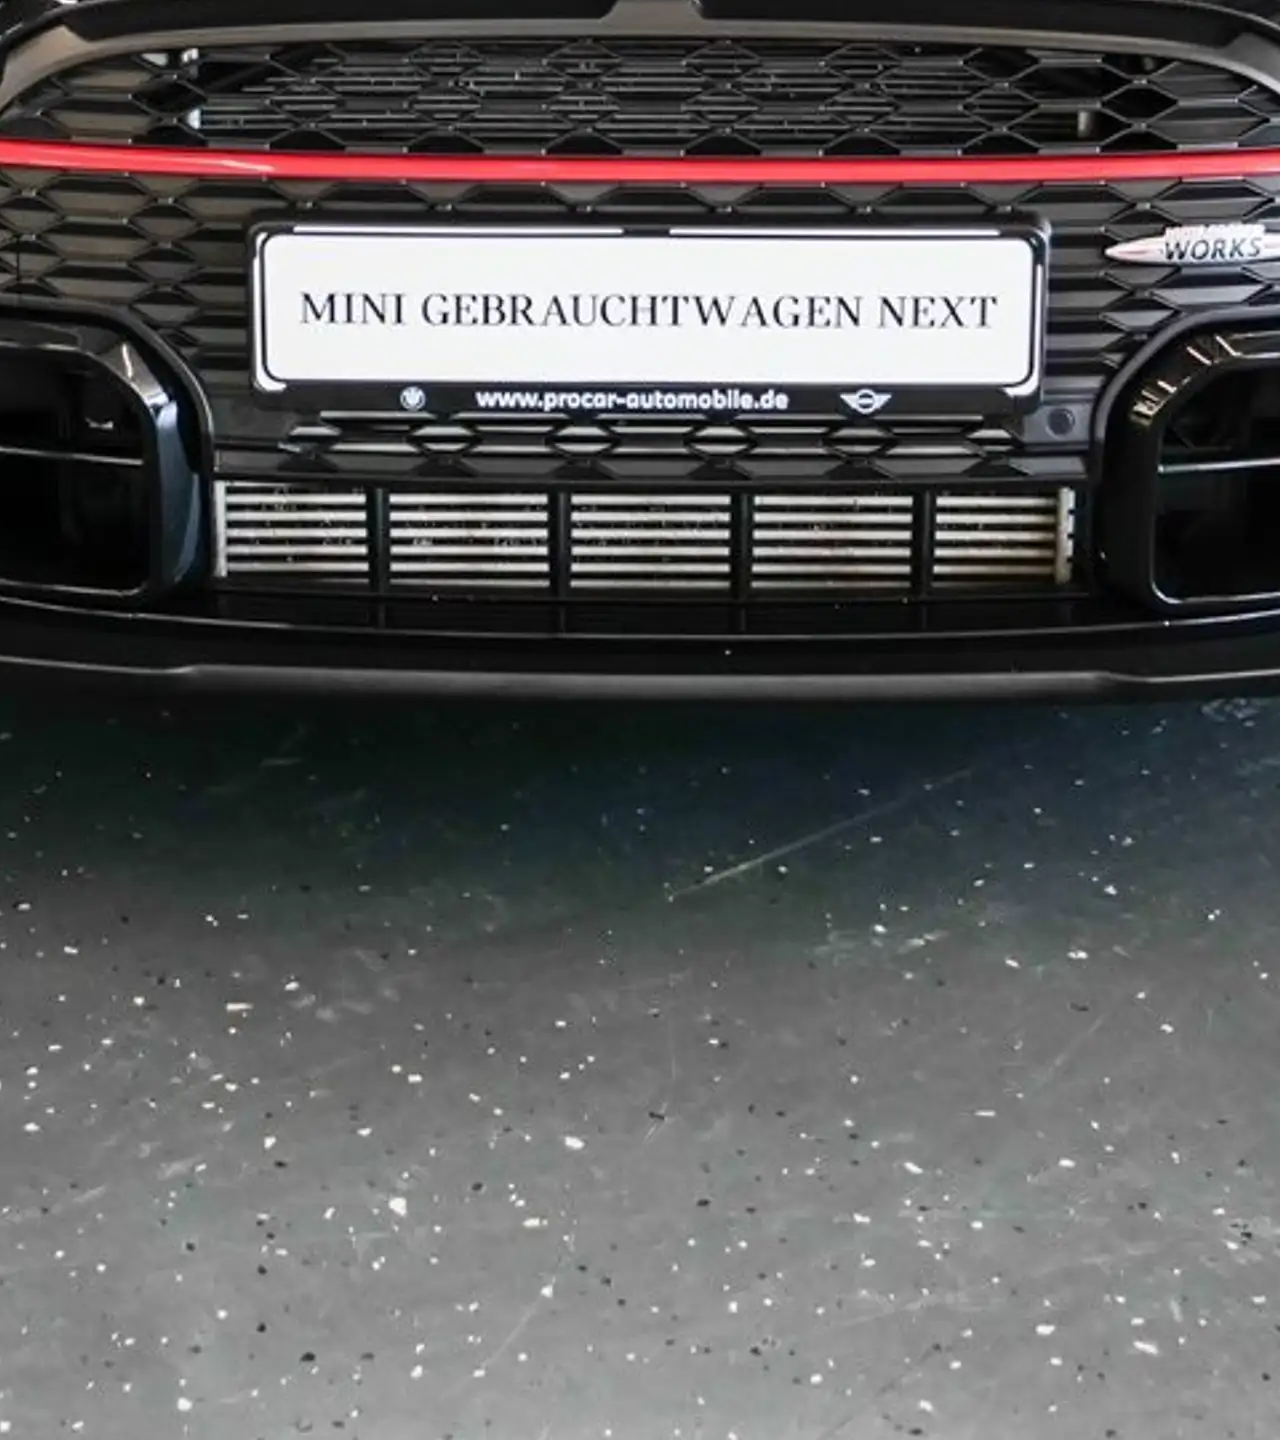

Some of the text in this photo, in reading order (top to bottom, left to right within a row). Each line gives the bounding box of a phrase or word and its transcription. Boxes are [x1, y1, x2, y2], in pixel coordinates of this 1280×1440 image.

[1163, 237, 1263, 262] WORKS
[299, 291, 999, 329] MINI GEBRAUCHTWAGEN NEXT
[475, 389, 790, 411] www.procar-automobile.de
